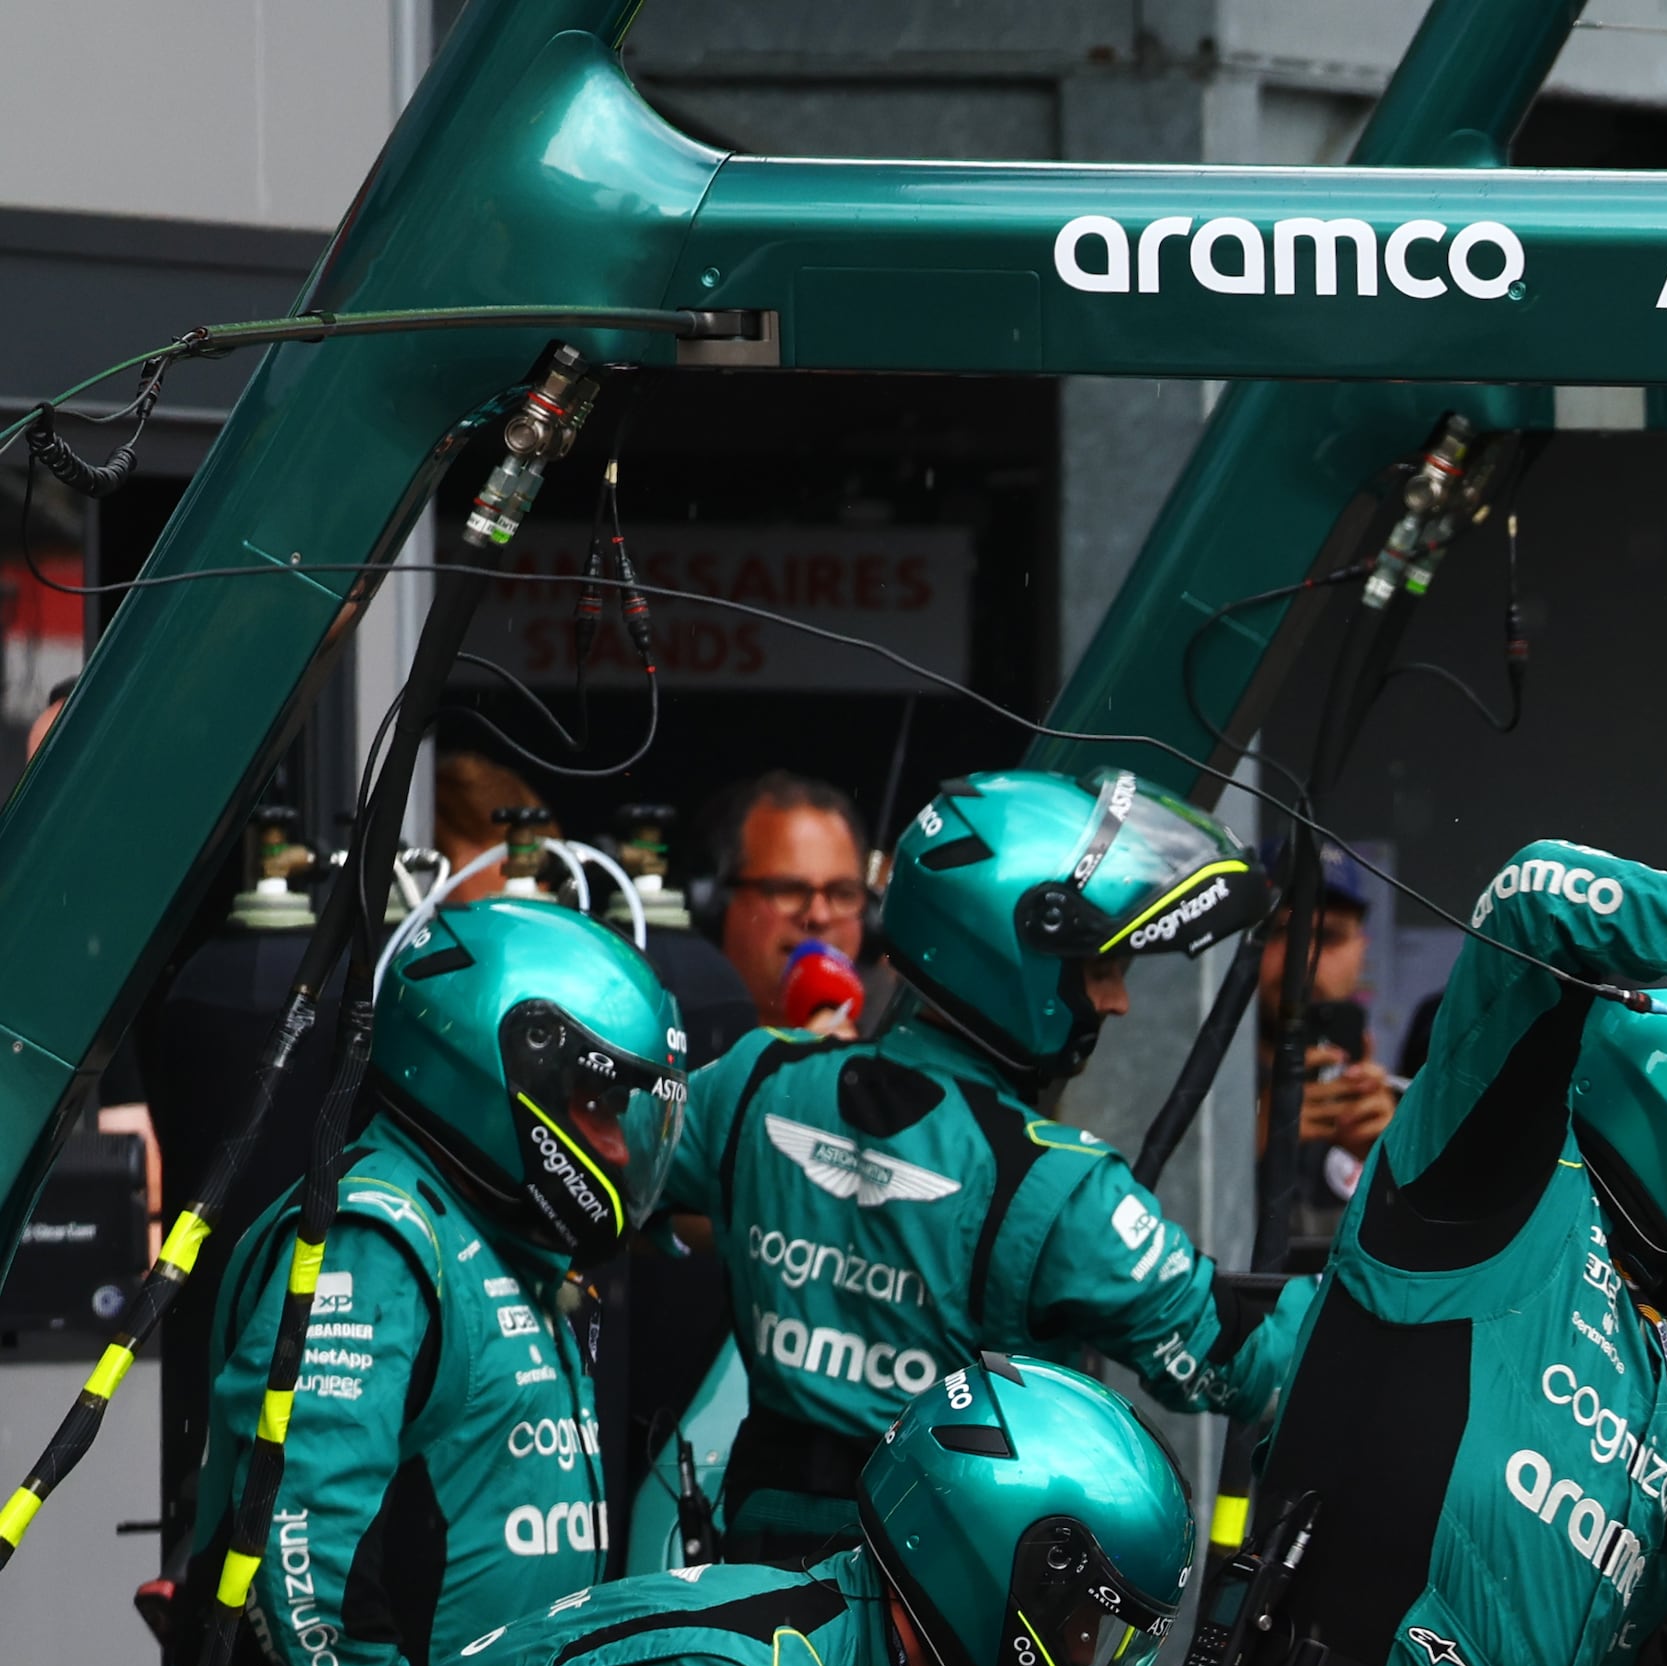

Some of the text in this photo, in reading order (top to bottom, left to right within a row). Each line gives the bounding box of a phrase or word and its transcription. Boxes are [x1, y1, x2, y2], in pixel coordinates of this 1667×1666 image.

[1054, 214, 1525, 300] aramco
[1129, 876, 1231, 949] cognizant
[1471, 858, 1624, 929] aramco
[530, 1125, 609, 1223] cognizant
[749, 1223, 931, 1307] cognizan
[304, 1348, 373, 1370] NetApp
